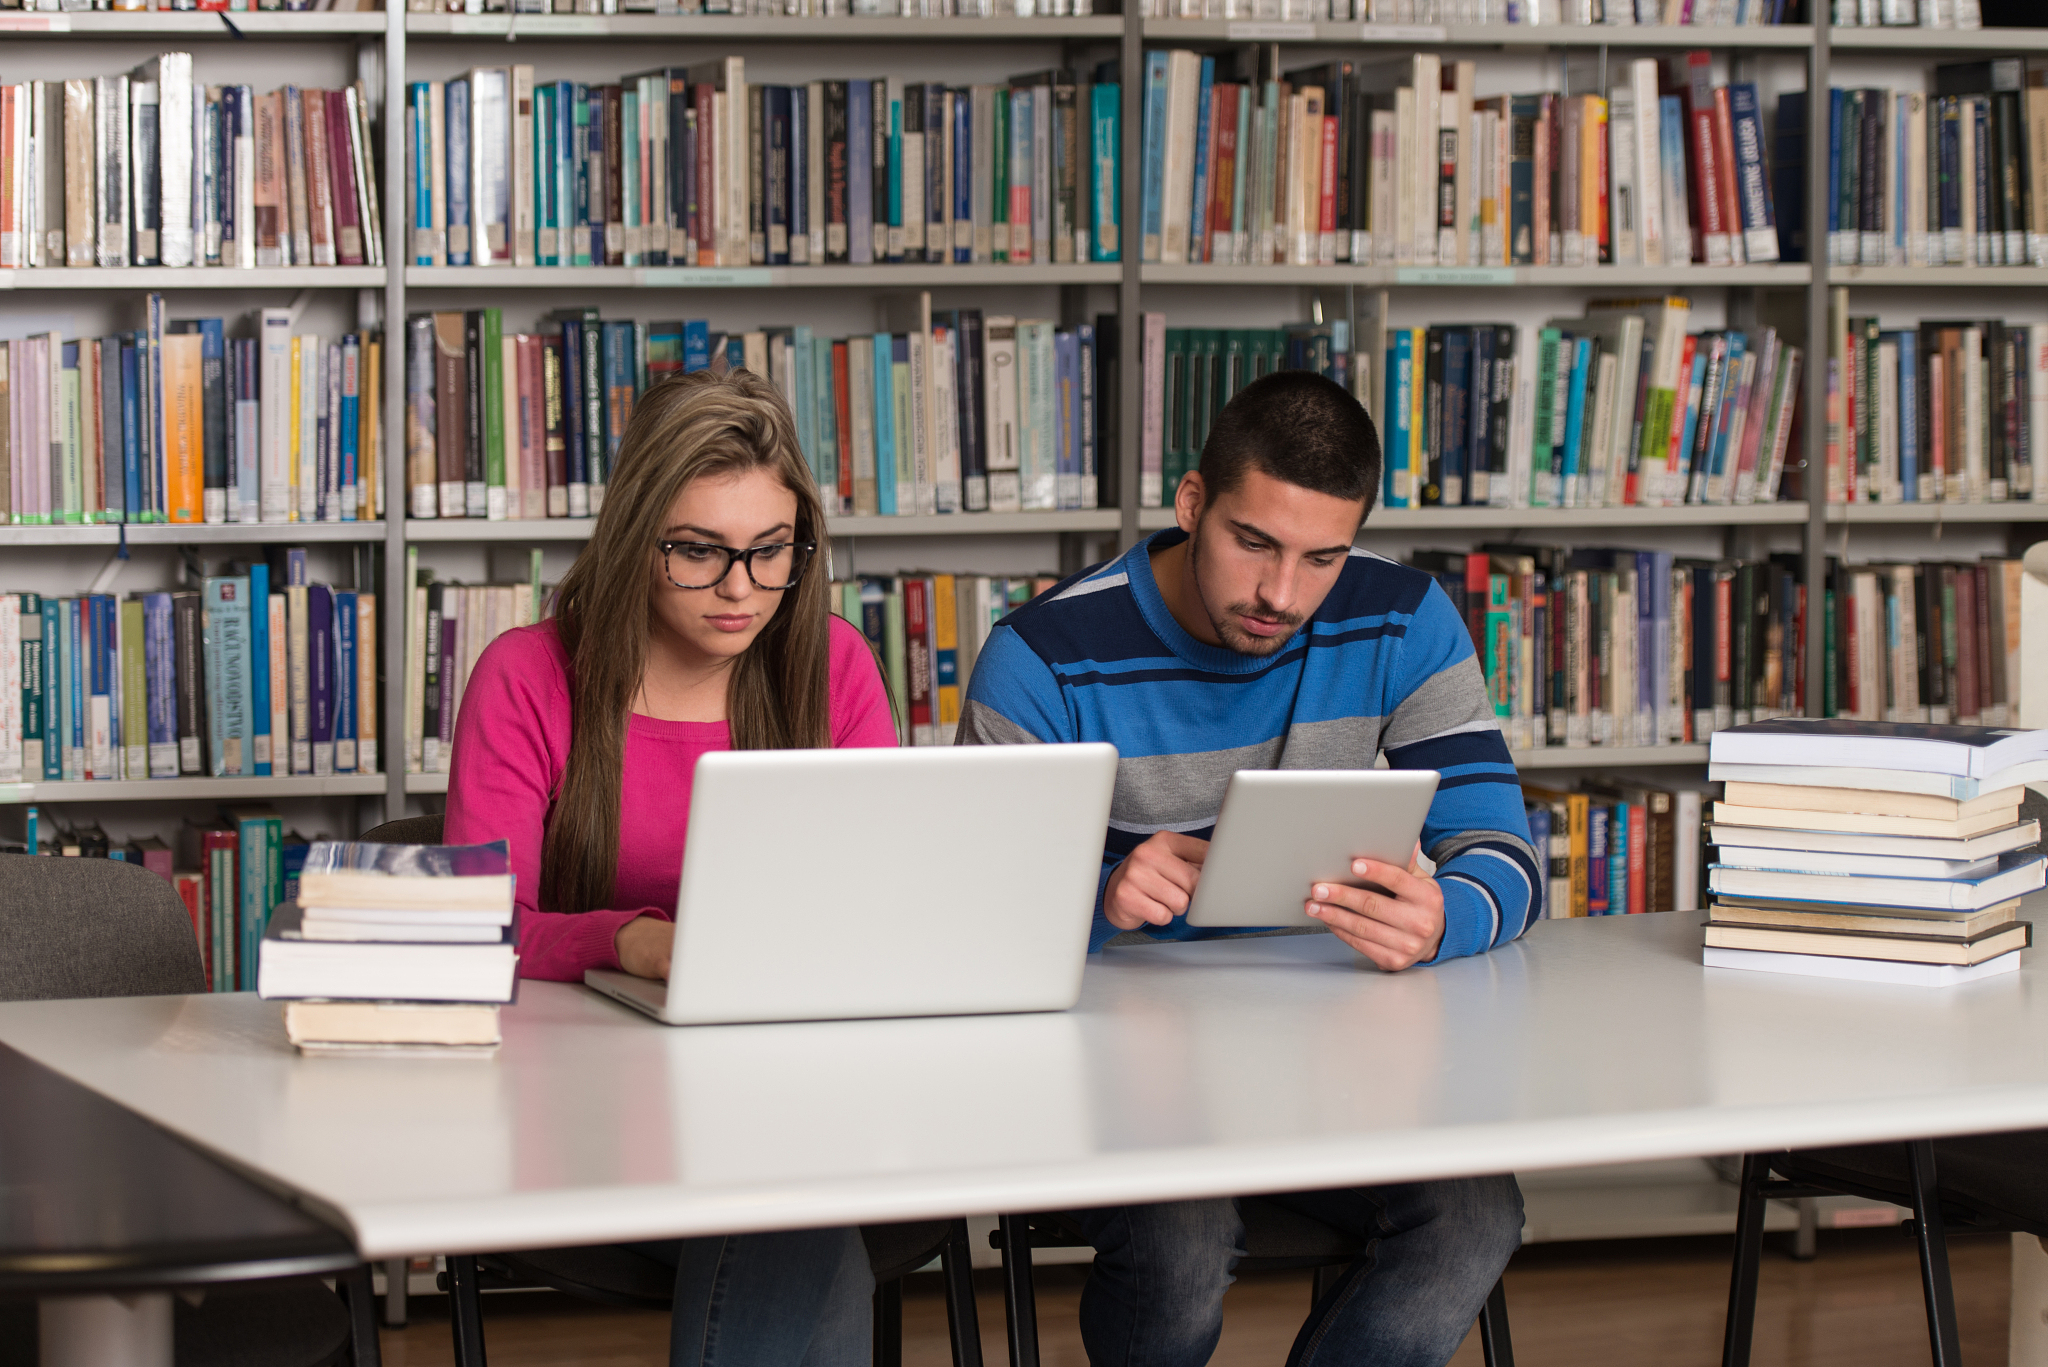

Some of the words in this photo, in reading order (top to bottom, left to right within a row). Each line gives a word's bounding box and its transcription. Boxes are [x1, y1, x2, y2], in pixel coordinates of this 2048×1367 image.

[1737, 116, 1759, 163] USLUGA
[1741, 162, 1767, 228] MARKETING
[22, 641, 33, 689] Accounting
